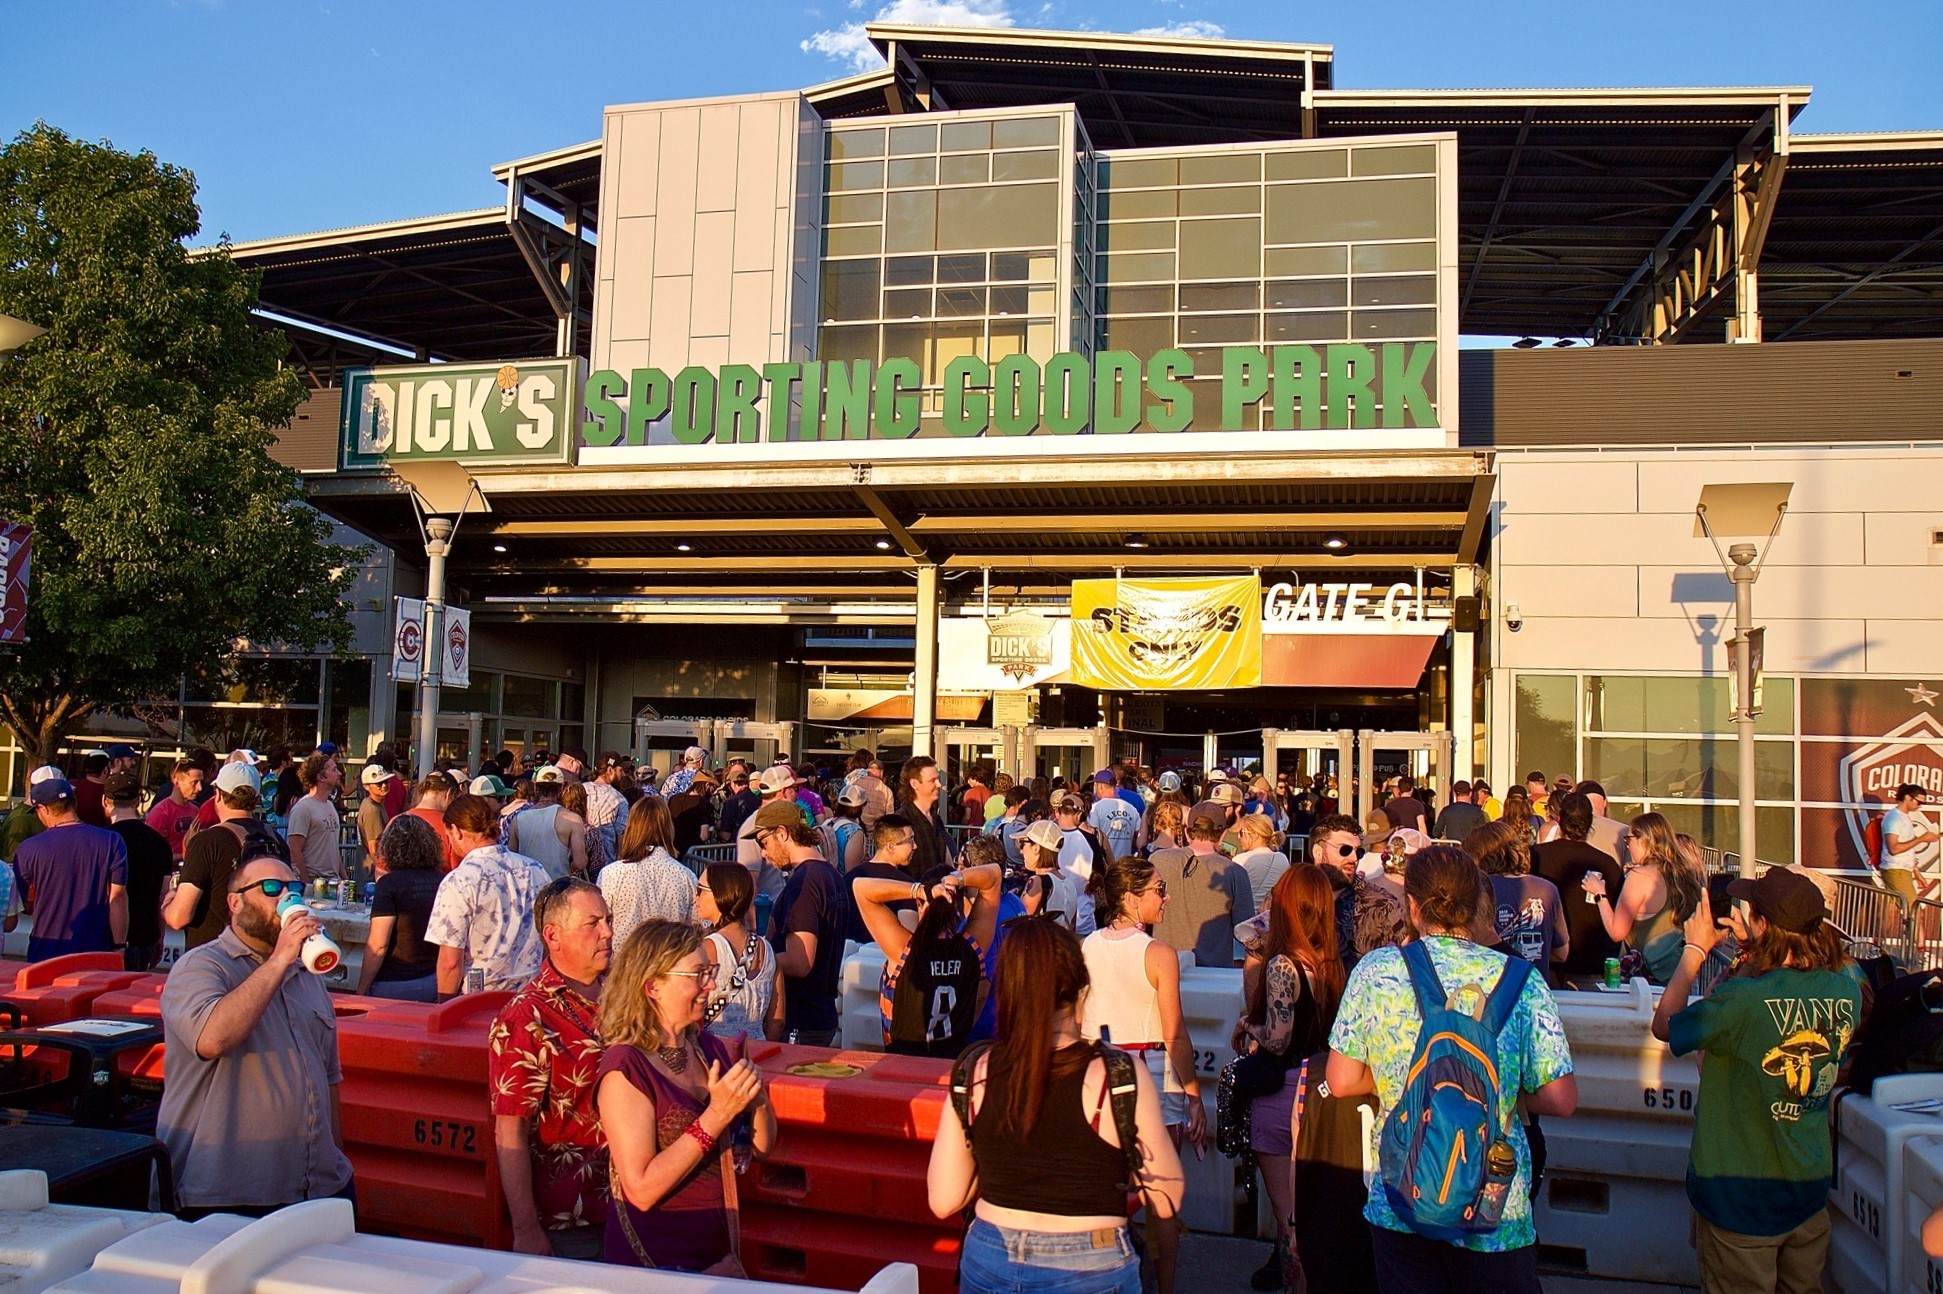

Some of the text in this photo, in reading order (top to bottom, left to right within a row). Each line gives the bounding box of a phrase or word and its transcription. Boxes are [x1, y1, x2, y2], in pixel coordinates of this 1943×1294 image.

[358, 367, 556, 454] DICK'S
[582, 343, 1440, 447] SPORTING GOODS PARK
[1091, 604, 1242, 633] STDS
[1264, 583, 1412, 622] GATE G
[991, 637, 1049, 657] DICK'S
[1007, 663, 1031, 672] PARK
[1868, 763, 1943, 793] COLORA
[1887, 789, 1943, 804] RDS
[926, 985, 957, 1041] 8
[1764, 998, 1855, 1037] VANS
[1644, 1087, 1697, 1115] 650
[414, 1119, 476, 1153] 6572
[1853, 1191, 1879, 1239] 6513
